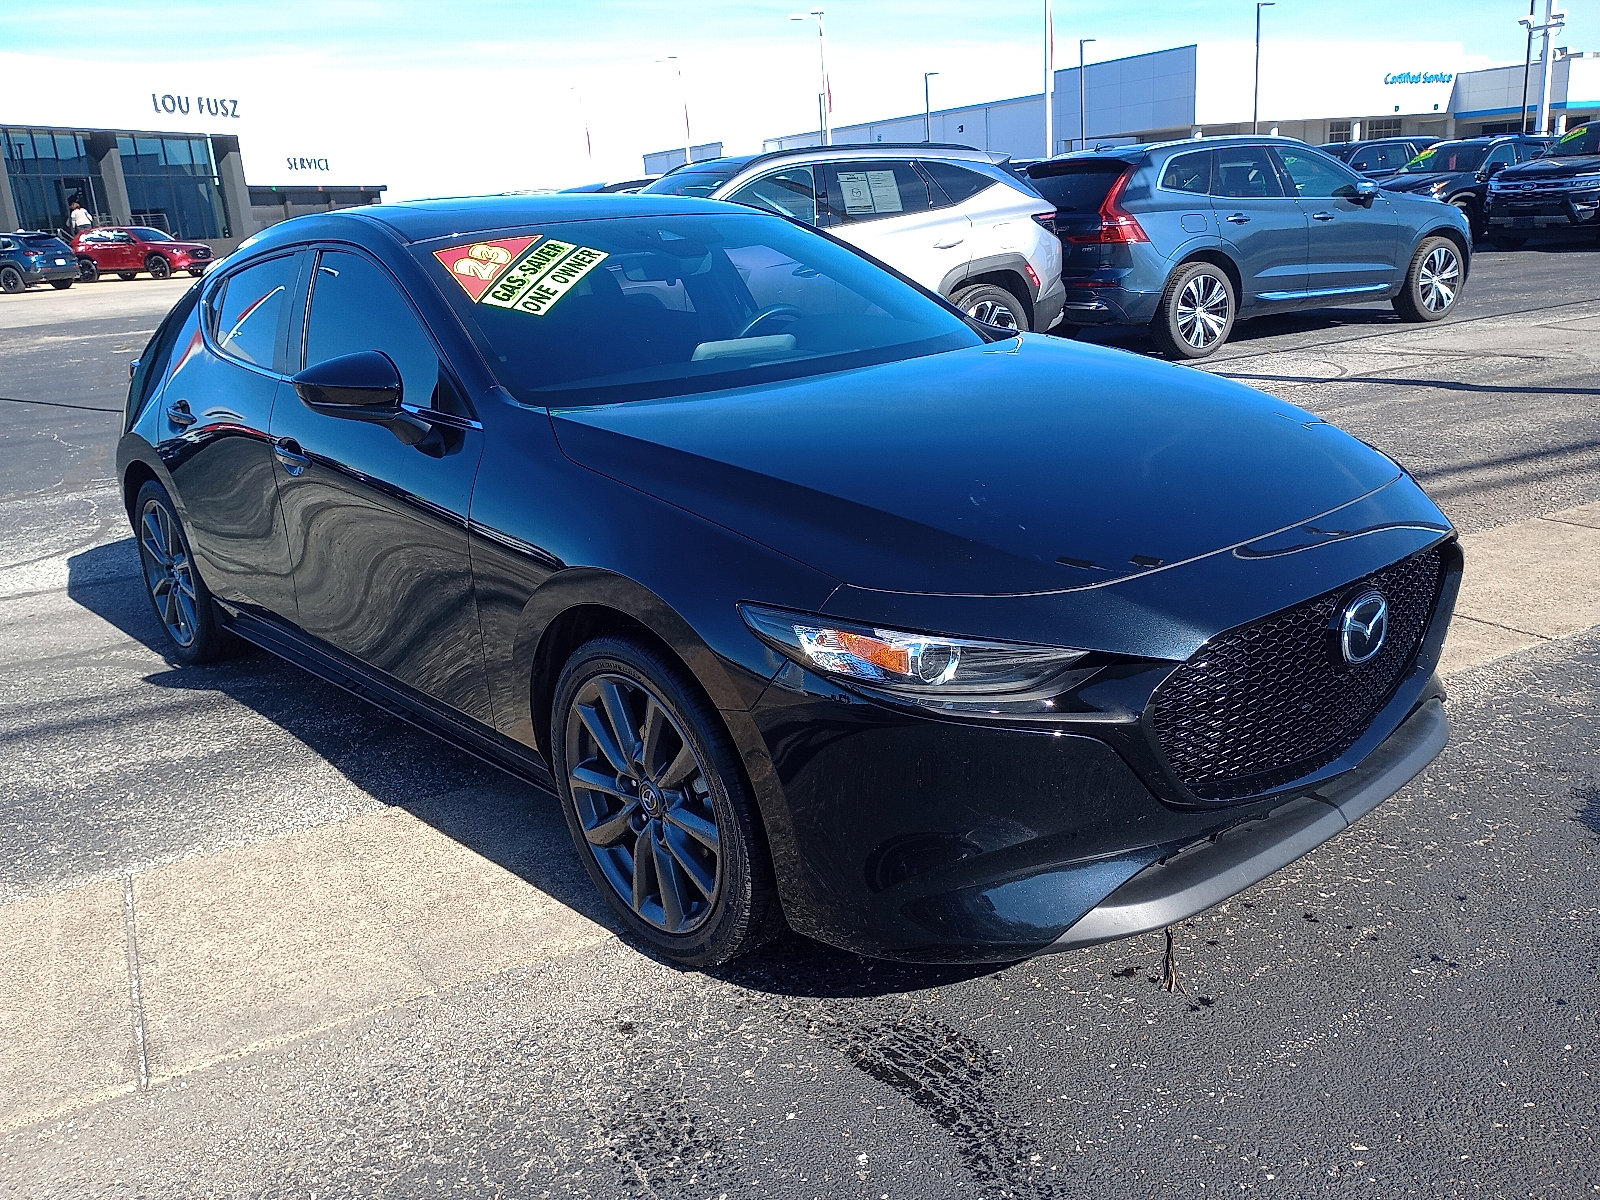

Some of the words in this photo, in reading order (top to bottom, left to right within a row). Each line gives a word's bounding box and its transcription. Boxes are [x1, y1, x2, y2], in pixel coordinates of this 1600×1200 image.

[1384, 71, 1421, 85] Certified
[1422, 71, 1453, 84] Service
[152, 93, 190, 116] LOU
[197, 96, 241, 119] FUSZ
[286, 157, 330, 171] SERVICE
[453, 244, 512, 280] 23
[521, 284, 559, 312] ONE
[550, 249, 602, 285] OWNER
